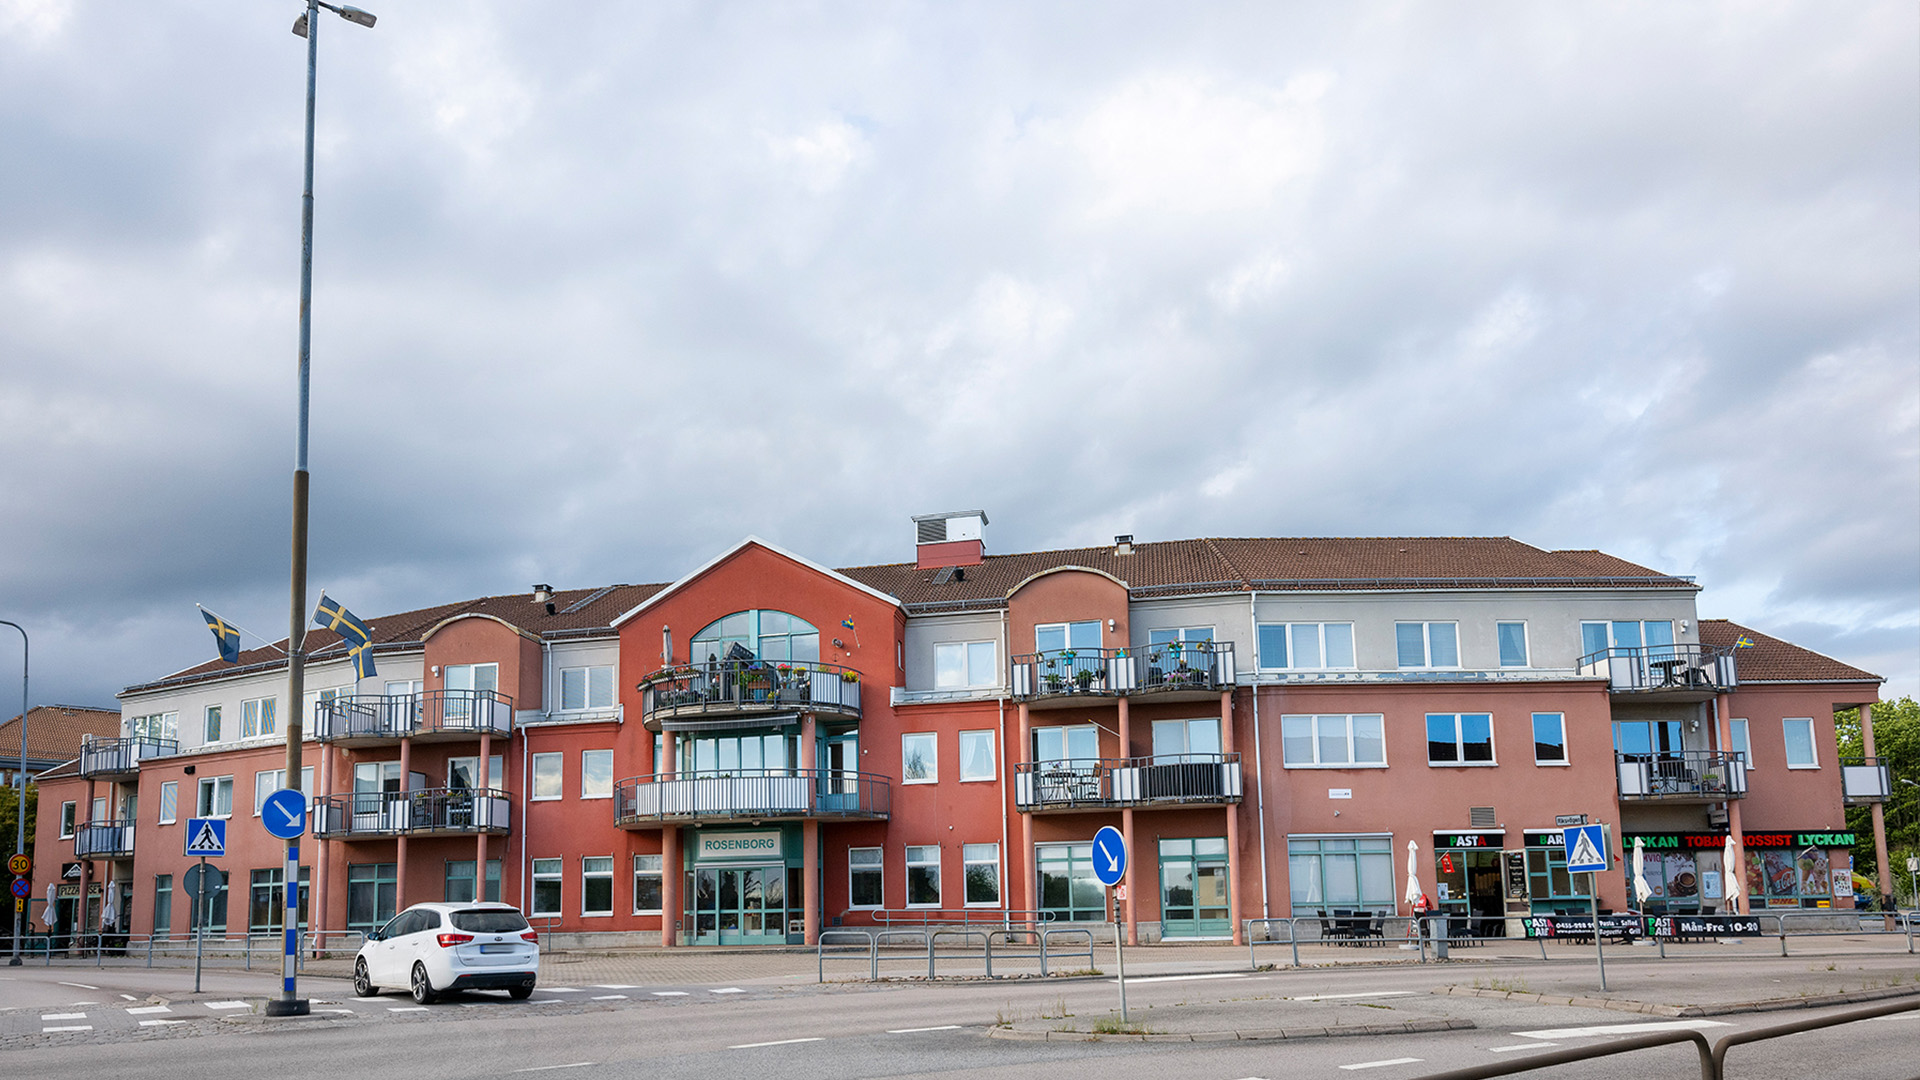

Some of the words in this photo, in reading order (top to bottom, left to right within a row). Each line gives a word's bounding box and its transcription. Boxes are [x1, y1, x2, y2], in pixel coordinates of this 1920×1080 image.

[705, 838, 775, 850] ROSENBORG
[1449, 835, 1487, 847] PASTA
[1540, 834, 1564, 845] BAR
[1797, 833, 1856, 846] LYCKAN
[12, 859, 28, 870] 30
[1524, 918, 1554, 928] PASTA
[1648, 918, 1676, 927] PASTA
[1681, 921, 1725, 932] Mån-Fre
[1729, 922, 1759, 932] 10-20
[1648, 926, 1677, 936] BAREN
